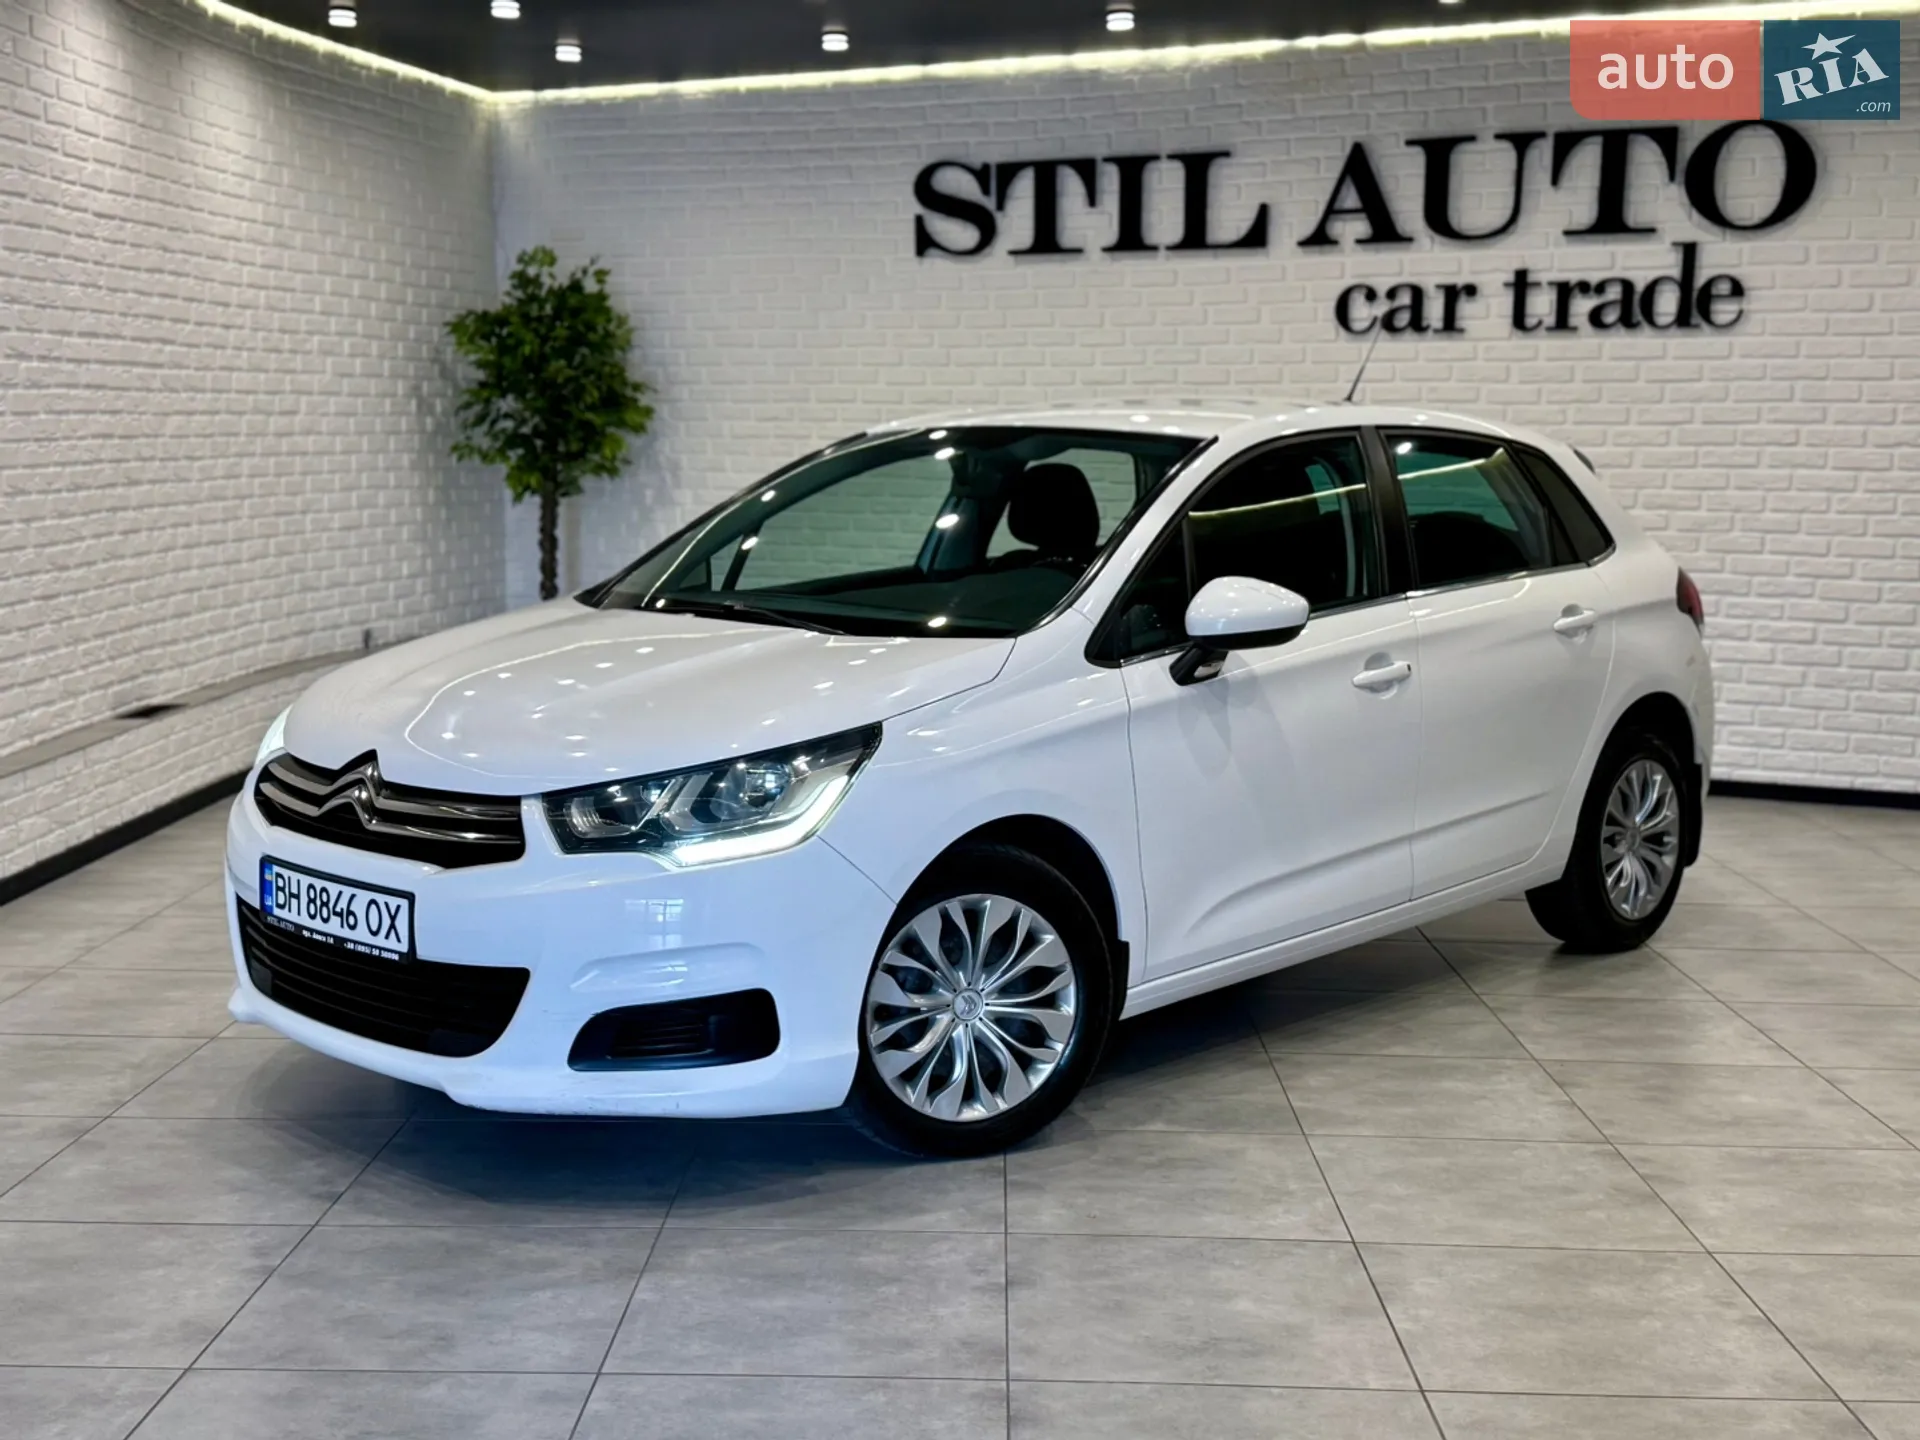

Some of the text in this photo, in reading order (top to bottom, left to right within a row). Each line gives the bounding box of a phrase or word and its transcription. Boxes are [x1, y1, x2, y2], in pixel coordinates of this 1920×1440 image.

[914, 119, 1817, 257] STIL AUTO
[1335, 241, 1744, 335] car trade
[275, 872, 402, 944] BH 8846 OX
